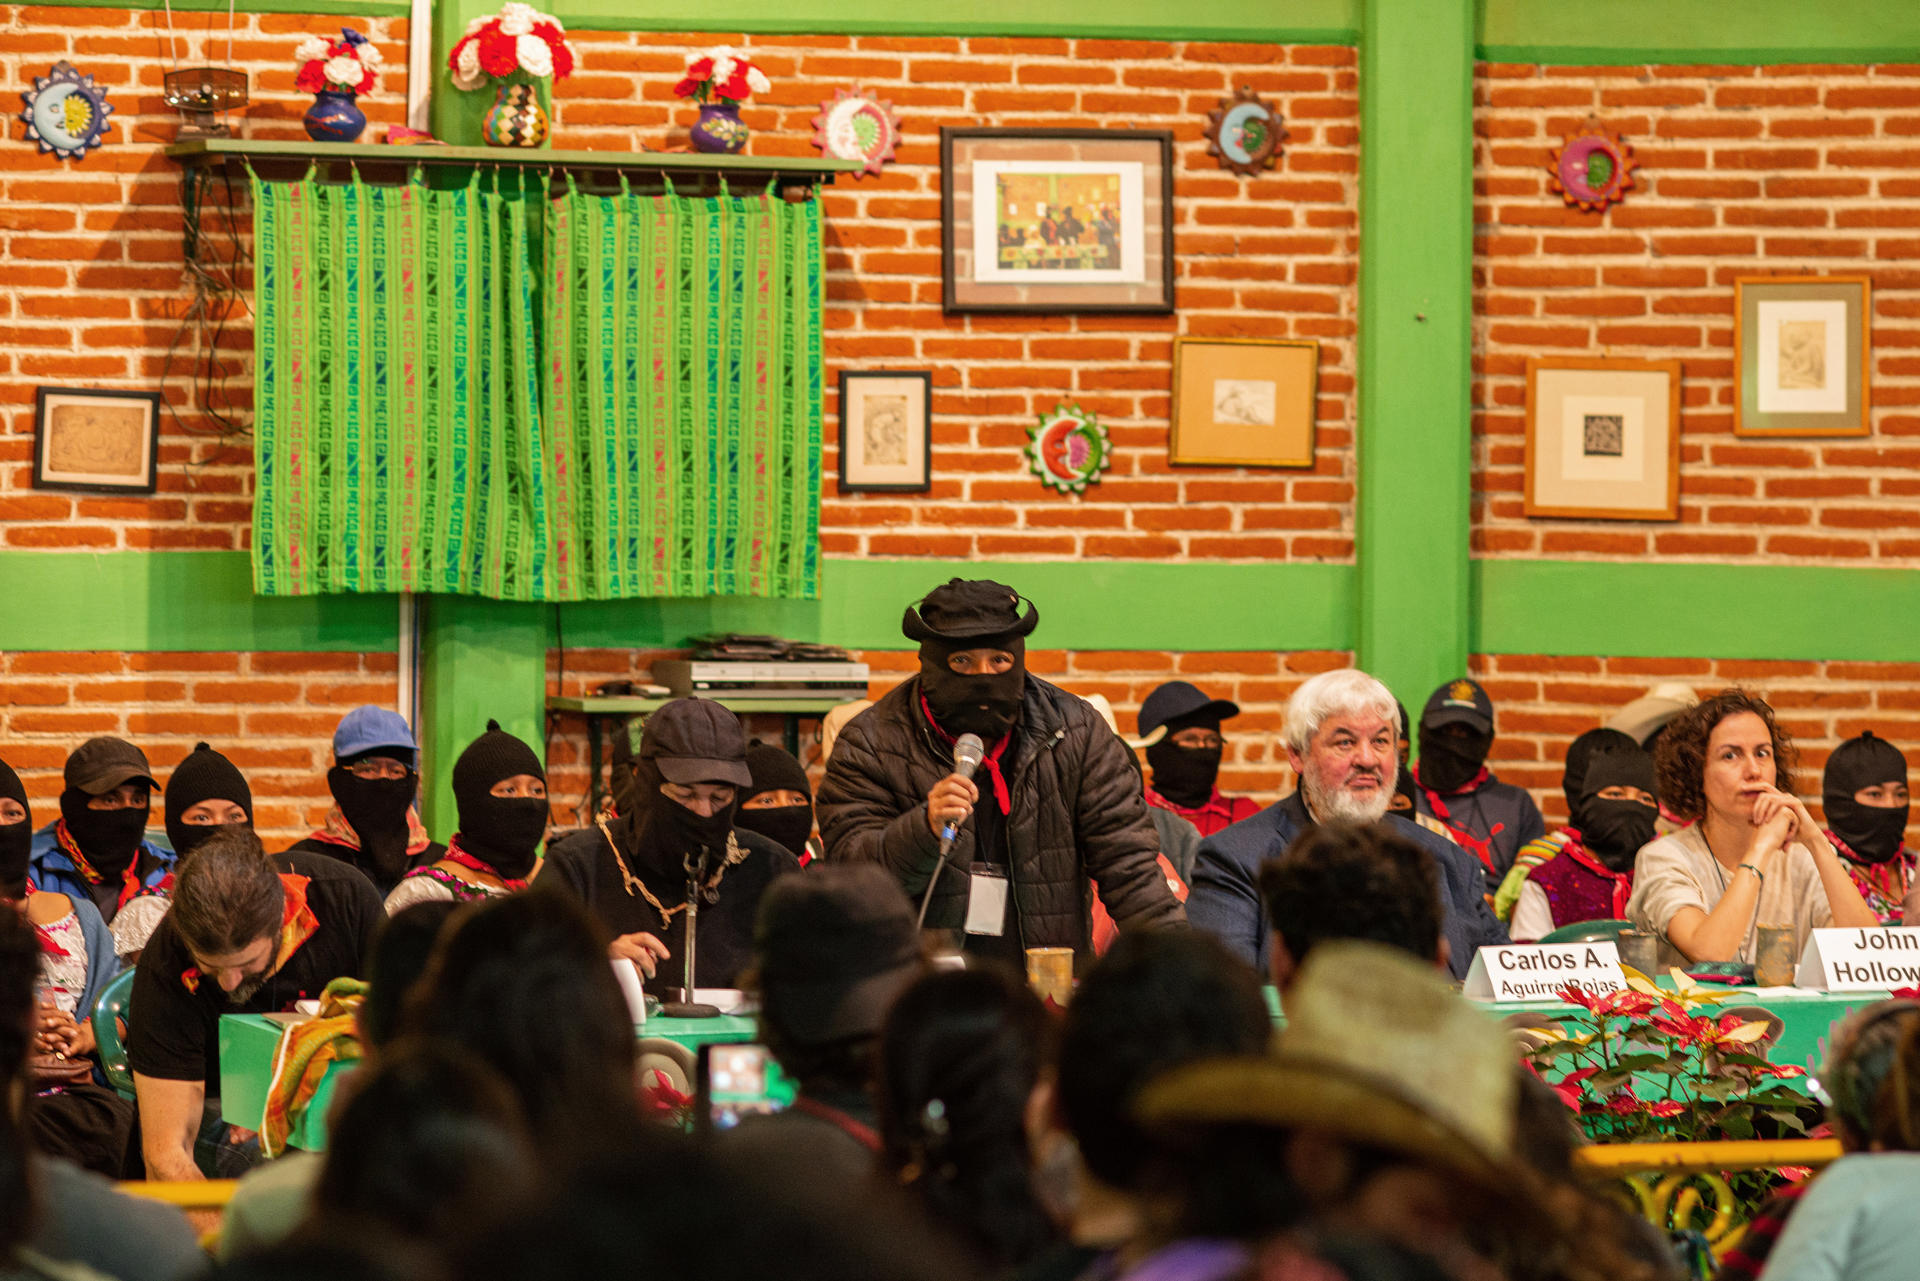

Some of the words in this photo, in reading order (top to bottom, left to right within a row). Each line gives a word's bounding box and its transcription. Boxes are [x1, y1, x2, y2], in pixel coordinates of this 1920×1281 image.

[1854, 928, 1919, 950] John
[1498, 949, 1577, 970] Carlos
[1584, 947, 1608, 968] A.
[1833, 961, 1920, 983] Hollow
[1502, 980, 1564, 998] Aguirre
